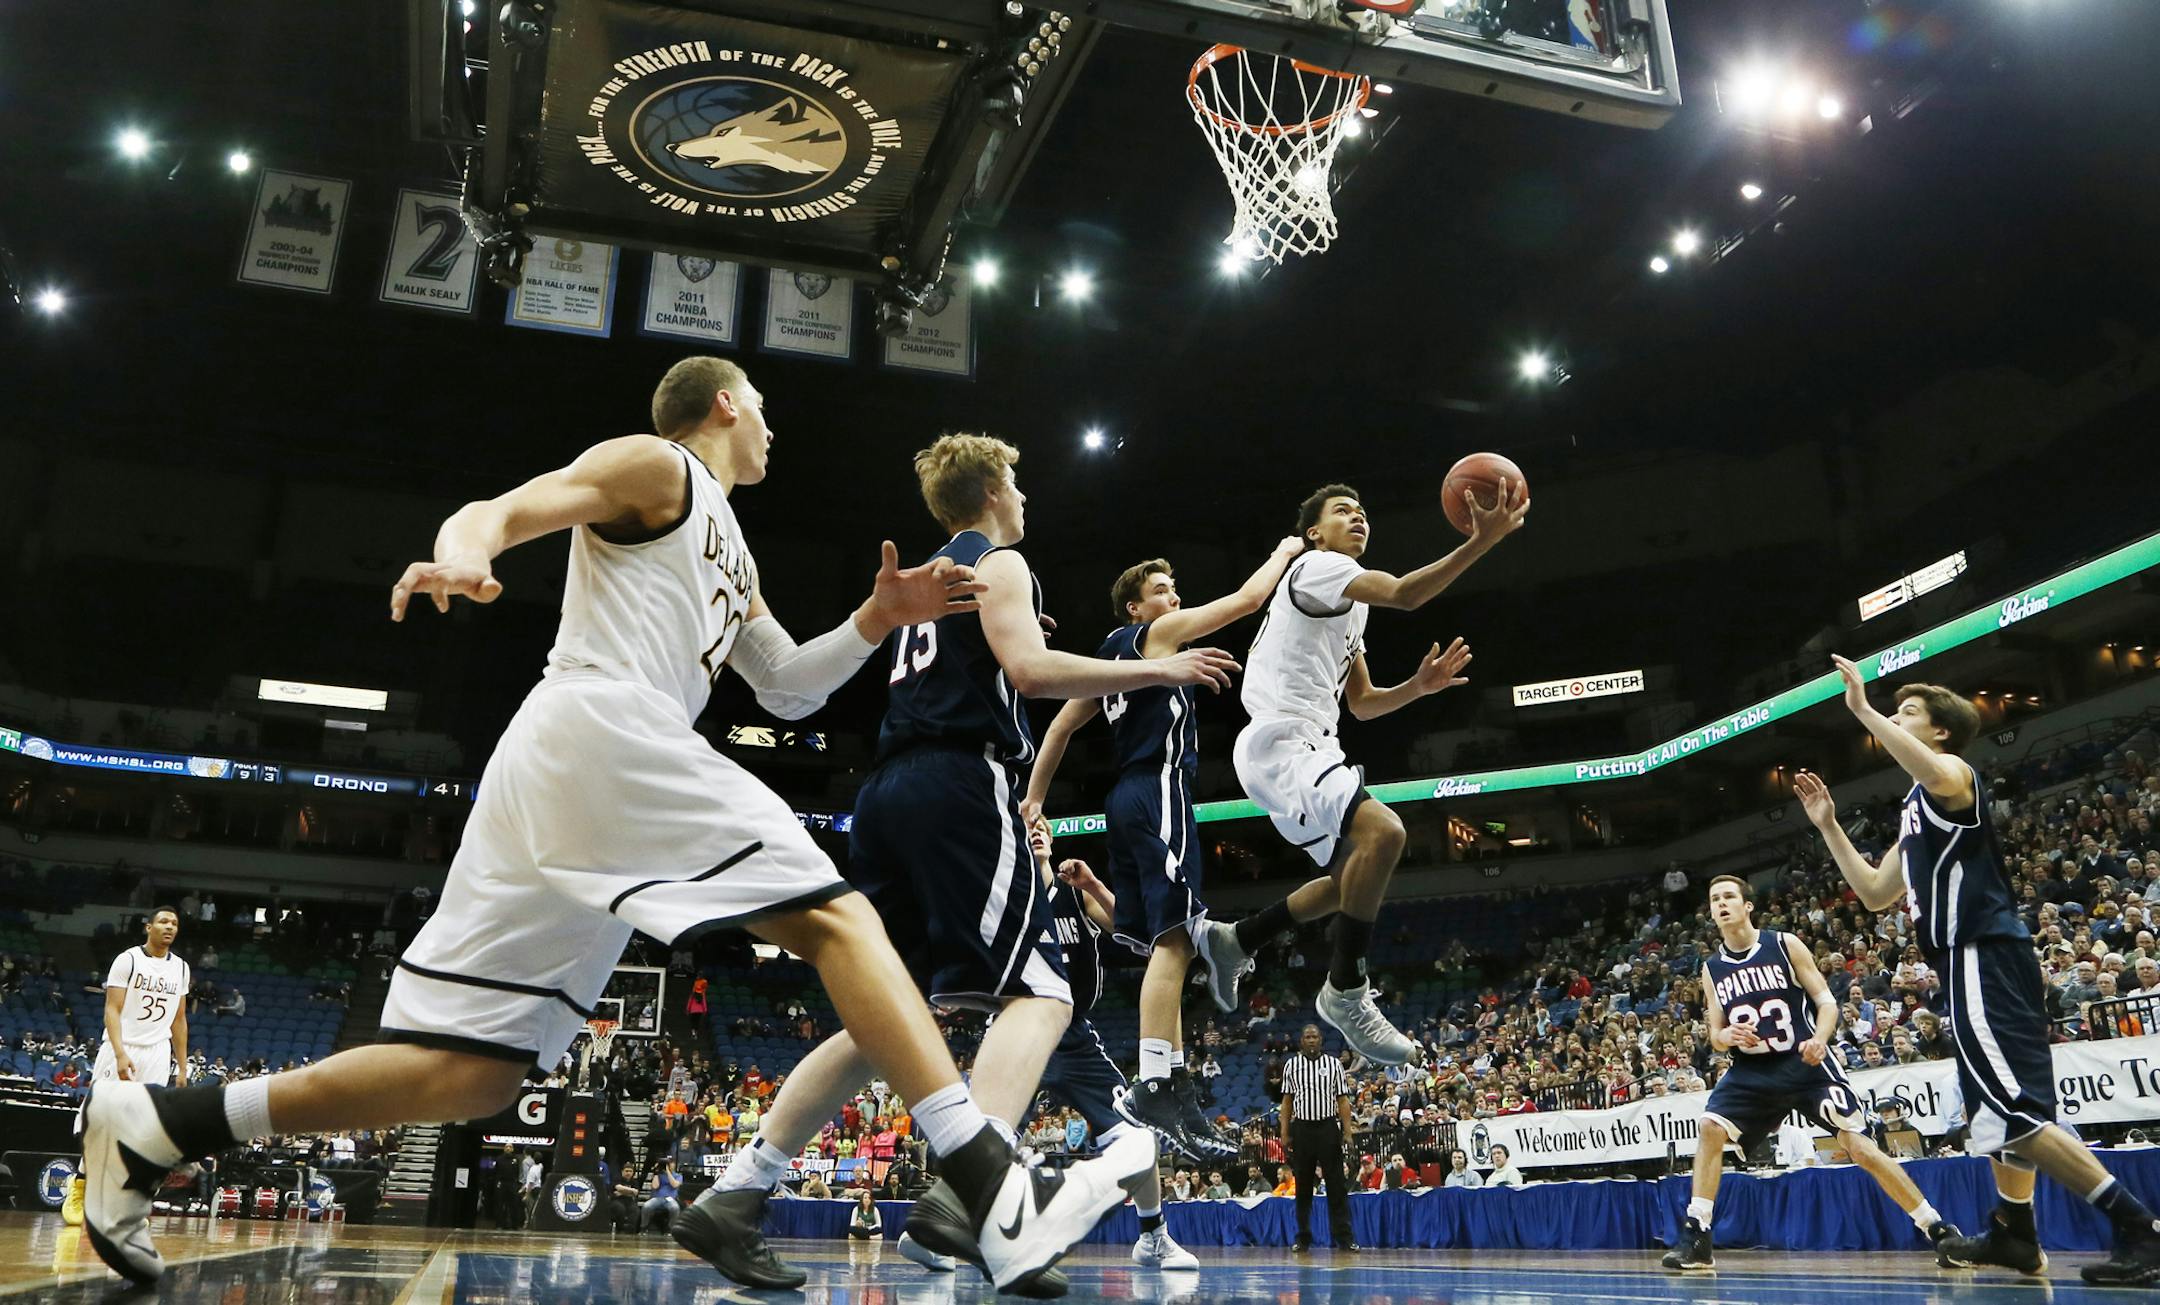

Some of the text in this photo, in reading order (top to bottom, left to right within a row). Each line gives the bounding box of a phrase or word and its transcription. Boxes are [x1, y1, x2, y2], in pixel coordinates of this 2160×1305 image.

[613, 41, 712, 80] STRENGTH
[719, 50, 744, 61] OF
[751, 52, 786, 69] THE
[789, 53, 849, 88] PACK
[600, 76, 629, 97] THE
[835, 86, 857, 100] IS
[588, 96, 610, 118] FOR
[852, 99, 879, 120] THE
[610, 164, 640, 183] THE
[864, 154, 887, 176] AND
[637, 182, 658, 194] IS
[844, 176, 873, 194] THE
[650, 192, 700, 215] WOLF
[705, 203, 737, 217] THE
[743, 208, 765, 217] OF
[770, 192, 858, 223] STRENGTH
[270, 241, 313, 255] 2003-04
[406, 202, 467, 281] 2
[256, 258, 319, 275] CHAMPIONS
[394, 283, 461, 301] MALIK SEALY
[526, 277, 543, 286] NBA
[544, 280, 565, 289] HALL
[578, 285, 600, 295] FAME
[678, 291, 705, 303] 2011
[674, 302, 707, 317] WNBA
[798, 310, 820, 320] 2011
[656, 313, 723, 331] CHAMPIONS
[780, 325, 836, 341] CHAMPIONS
[918, 327, 940, 338] 2012
[901, 342, 955, 359] CHAMPIONS
[890, 621, 938, 684] 15
[1517, 676, 1640, 700] TARGET CENTER
[1576, 708, 1770, 779] Putting It All On The Table
[240, 770, 275, 782] 9 3
[433, 783, 460, 797] 41
[818, 820, 827, 829] 7
[1056, 817, 1107, 834] All On
[1716, 964, 1789, 1006] SPARTANS
[137, 995, 167, 1022] 35
[2054, 1073, 2115, 1116] gue
[518, 1093, 547, 1126] G
[1515, 1126, 1587, 1154] Welcome
[1590, 1125, 1607, 1149] to
[1611, 1118, 1642, 1147] the
[1645, 1111, 1702, 1144] Minn
